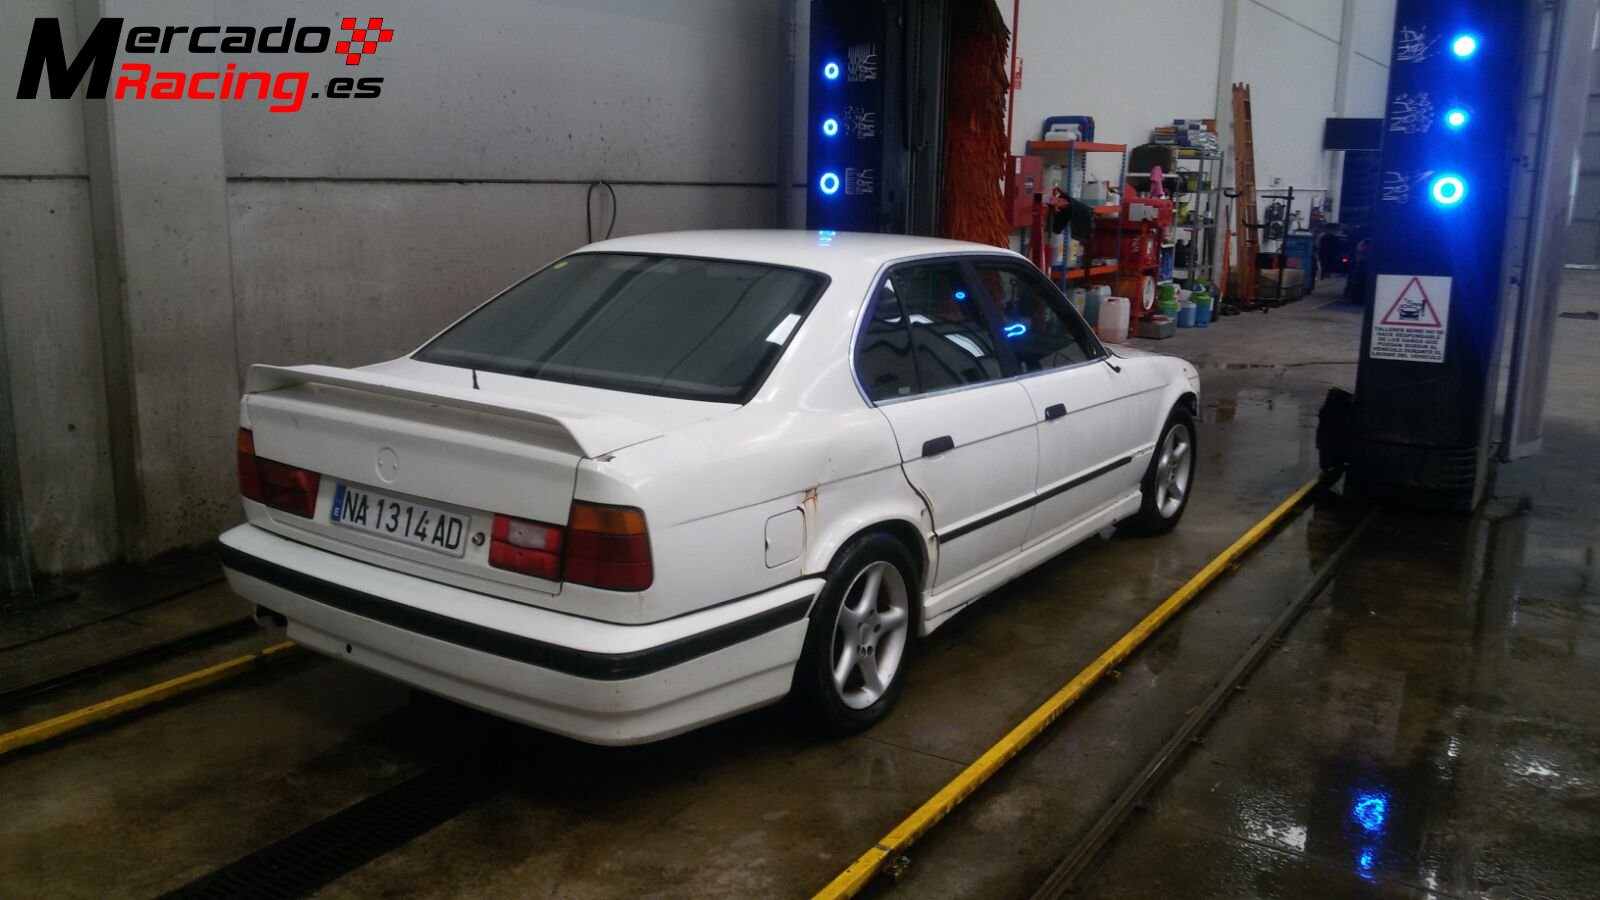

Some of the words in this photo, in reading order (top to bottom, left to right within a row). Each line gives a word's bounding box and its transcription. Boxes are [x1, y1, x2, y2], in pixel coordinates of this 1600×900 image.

[342, 490, 369, 526] NA
[375, 498, 429, 542] 1314
[431, 514, 463, 550] AD
